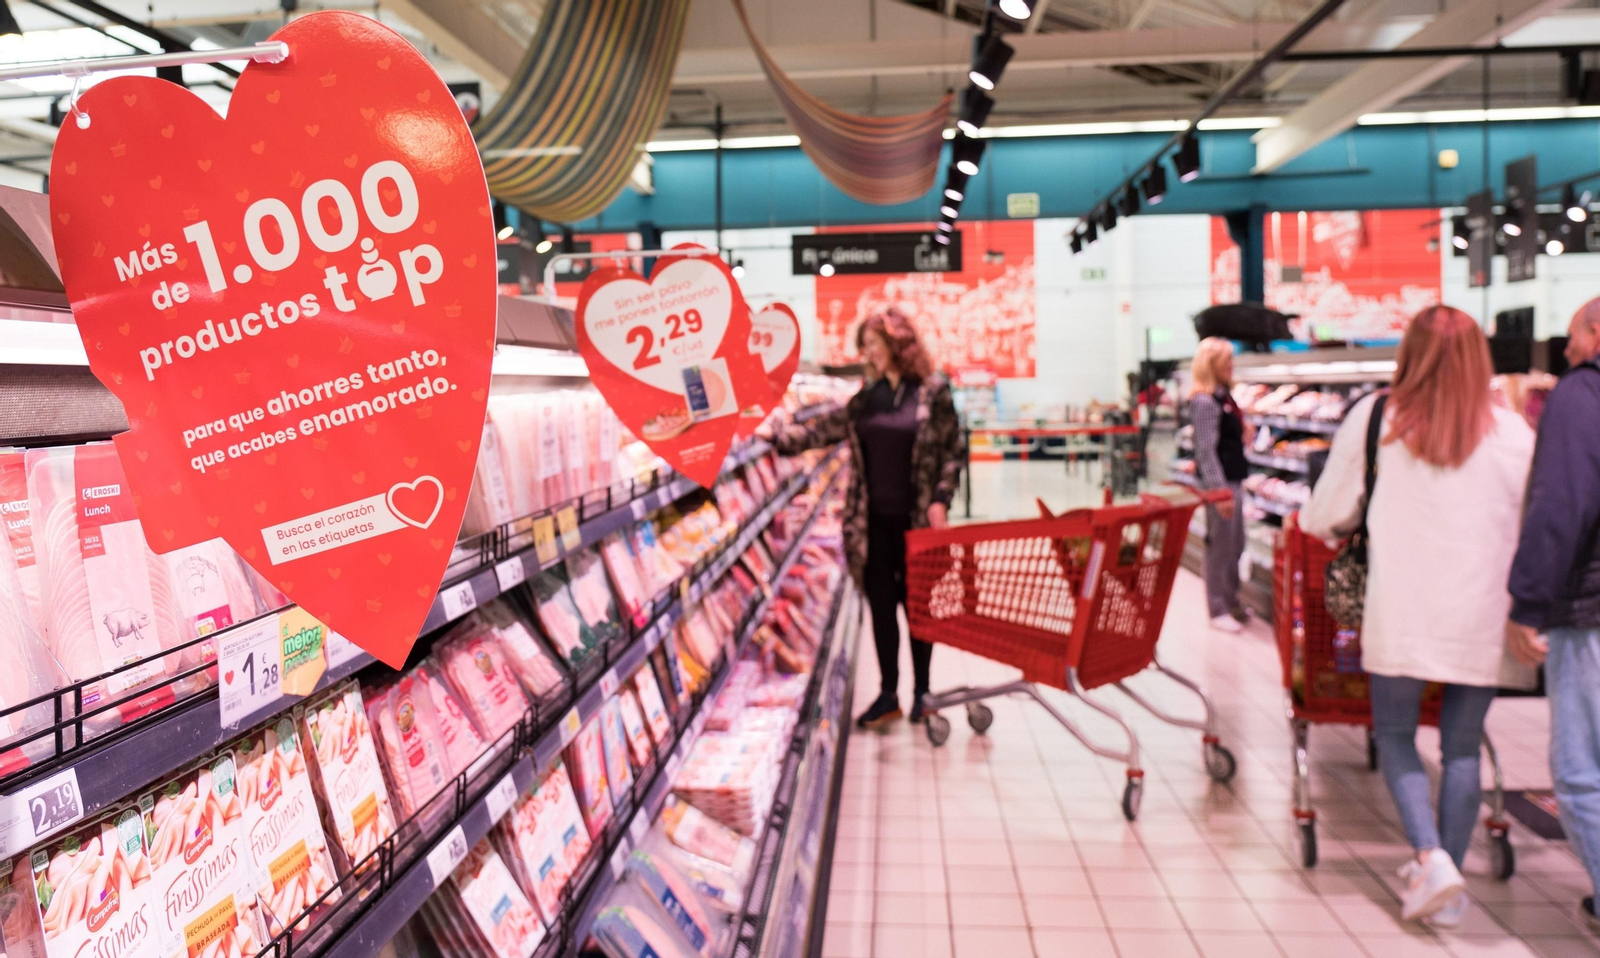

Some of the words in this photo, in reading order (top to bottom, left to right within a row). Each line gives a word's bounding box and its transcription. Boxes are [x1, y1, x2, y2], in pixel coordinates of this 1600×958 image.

[182, 159, 419, 293] 1.000
[113, 240, 178, 281] Más
[151, 281, 190, 310] de
[593, 317, 615, 330] me
[617, 306, 657, 327] pones
[659, 284, 719, 309] tontorrón
[614, 293, 636, 310] Sin
[637, 290, 655, 303] ser
[659, 281, 691, 298] pavo
[140, 293, 320, 381] productos
[626, 308, 703, 370] 2,29
[182, 417, 226, 448] para
[228, 404, 265, 432] que
[266, 371, 364, 416] ahorres
[366, 348, 447, 384] tanto,
[190, 448, 226, 474] que
[227, 423, 298, 460] acabes
[299, 375, 458, 436] enamorado.
[84, 503, 111, 517] Lunch
[93, 486, 119, 497] EROSKI
[276, 518, 313, 541] Busca
[314, 516, 326, 531] el
[327, 502, 376, 526] corazón
[281, 543, 298, 556] en
[298, 535, 317, 552] las
[317, 520, 375, 547] etiquetas
[32, 783, 74, 835] 2,19
[186, 915, 214, 940] PECHUGA
[218, 900, 234, 917] PAVO
[196, 920, 231, 951] BRASEADA
